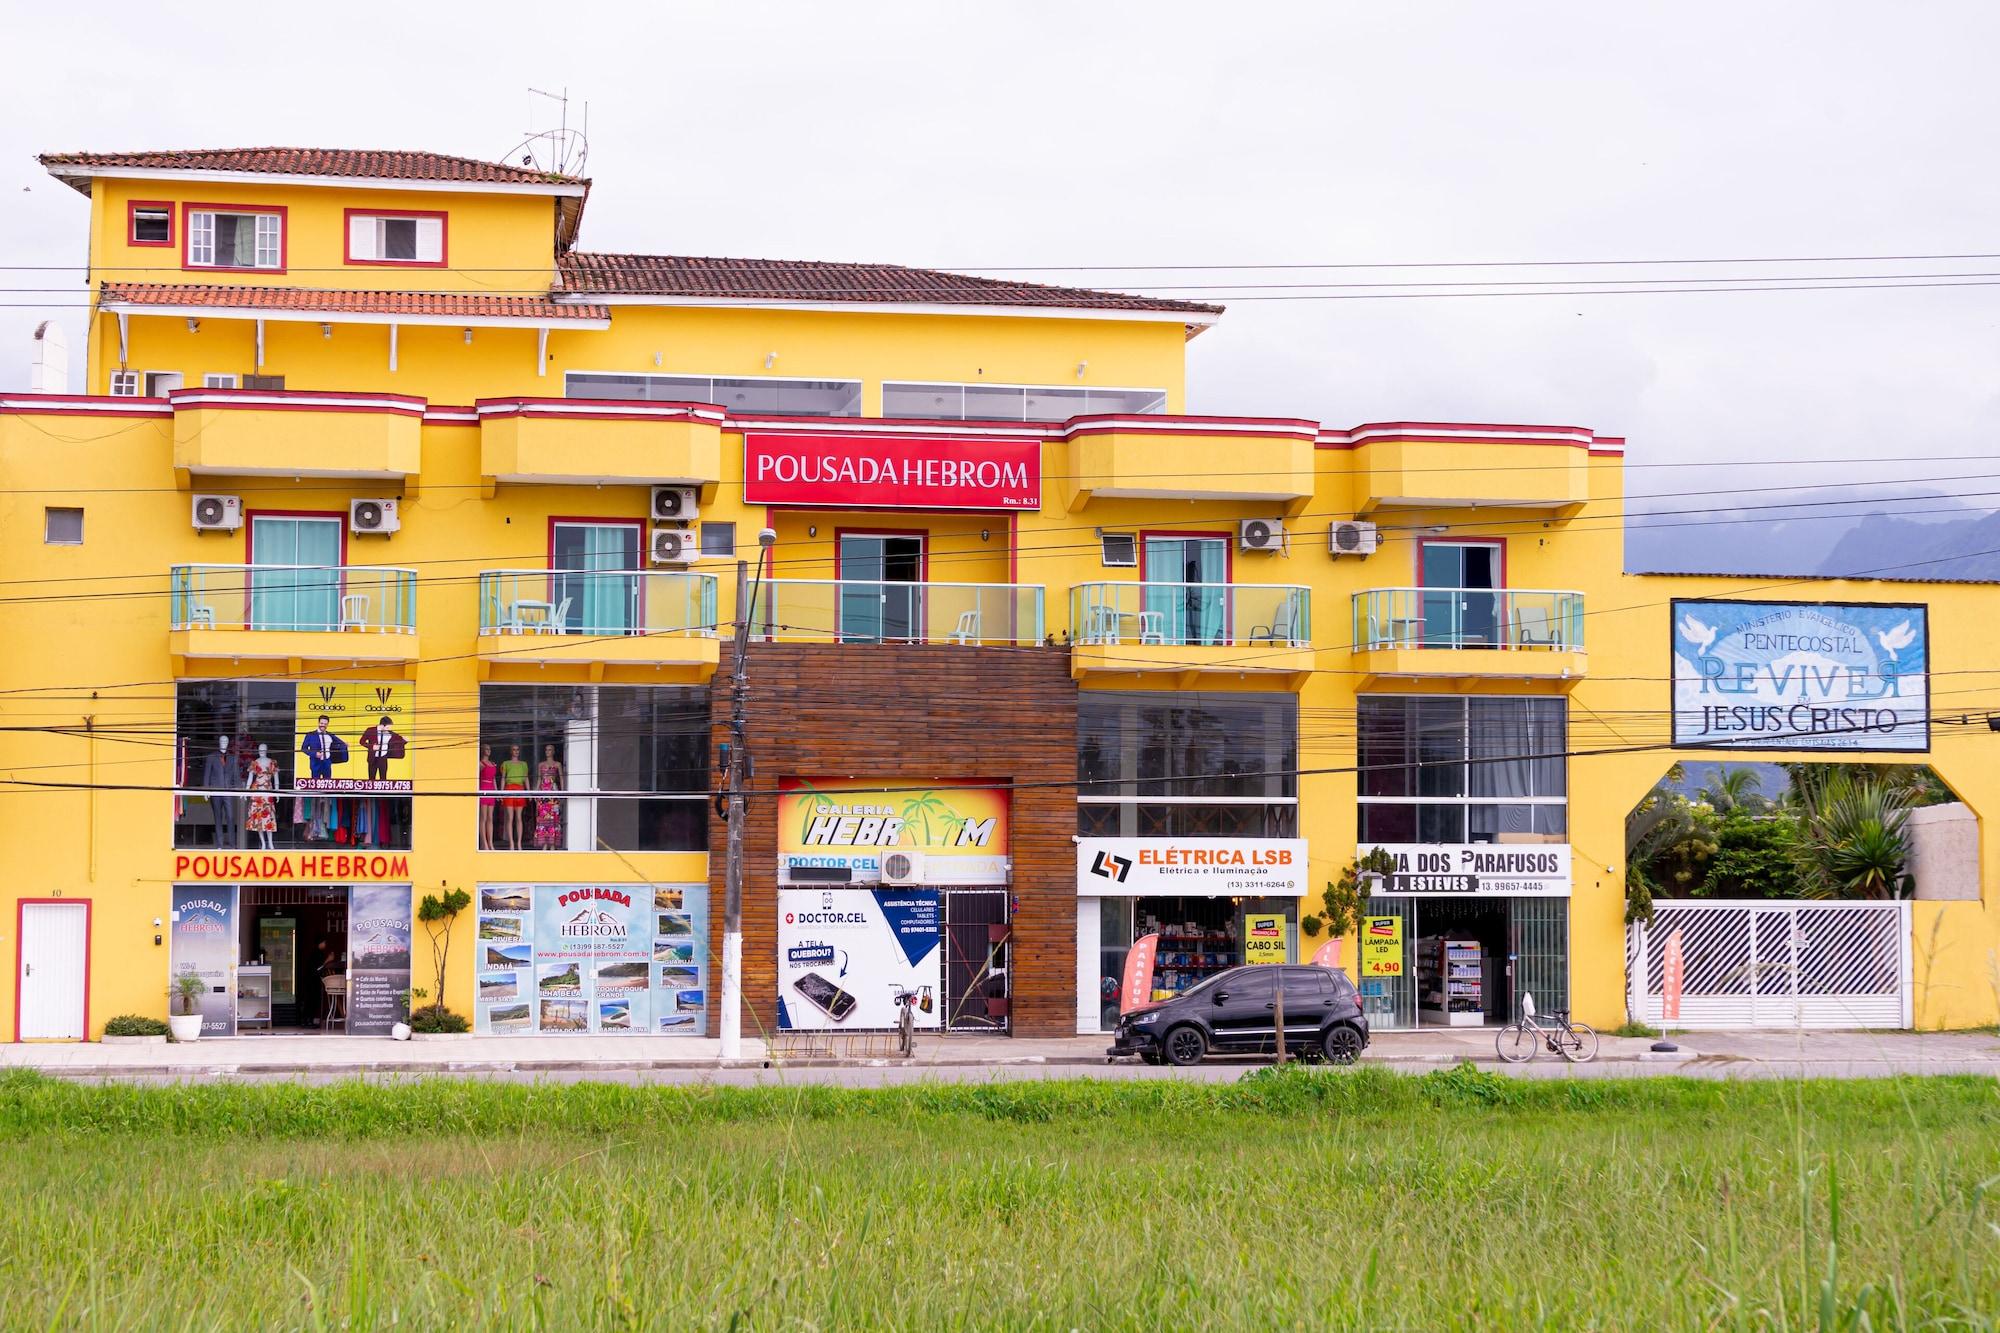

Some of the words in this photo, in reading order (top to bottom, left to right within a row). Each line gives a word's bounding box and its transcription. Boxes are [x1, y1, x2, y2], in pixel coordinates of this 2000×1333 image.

[757, 454, 898, 485] POUSADA
[903, 459, 1028, 489] HEBROM
[1023, 497, 1038, 506] 8.31
[1744, 633, 1863, 653] PENTECOSTAL
[1699, 656, 1900, 698] REVIVER
[1697, 705, 1783, 736] JESUS
[1787, 704, 1898, 734] CRISTO
[307, 779, 316, 788] 13
[364, 781, 373, 790] 13
[815, 805, 895, 816] GALERIA
[1138, 845, 1246, 865] ELÉTRICA
[1252, 849, 1293, 865] LSB
[175, 855, 294, 878] POUSADA
[300, 855, 409, 878] HEBROM
[1417, 853, 1451, 873] DOS
[1461, 850, 1559, 873] PARAFUSOS
[1159, 866, 1200, 875] Elétrica
[1203, 867, 1209, 875] e
[1212, 866, 1269, 876] Iluminação
[1227, 881, 1243, 889] (13)
[1392, 876, 1404, 891] J.
[1409, 876, 1469, 891] ESTEVES
[1494, 882, 1543, 891] 99657-4445
[557, 887, 632, 908] POUSADA
[180, 899, 227, 917] POUSADA
[798, 912, 867, 923] DOCTOR.CEL
[180, 923, 224, 932] HEBROM
[356, 919, 410, 932] POUSADA
[561, 925, 626, 936] HEBROM
[1246, 941, 1271, 950] CABO
[1273, 941, 1286, 950] SIL
[1364, 936, 1400, 946] LÂMPADA
[790, 948, 832, 959] QUEBROU?
[1372, 962, 1400, 974] 4,90
[560, 989, 583, 997] BELA
